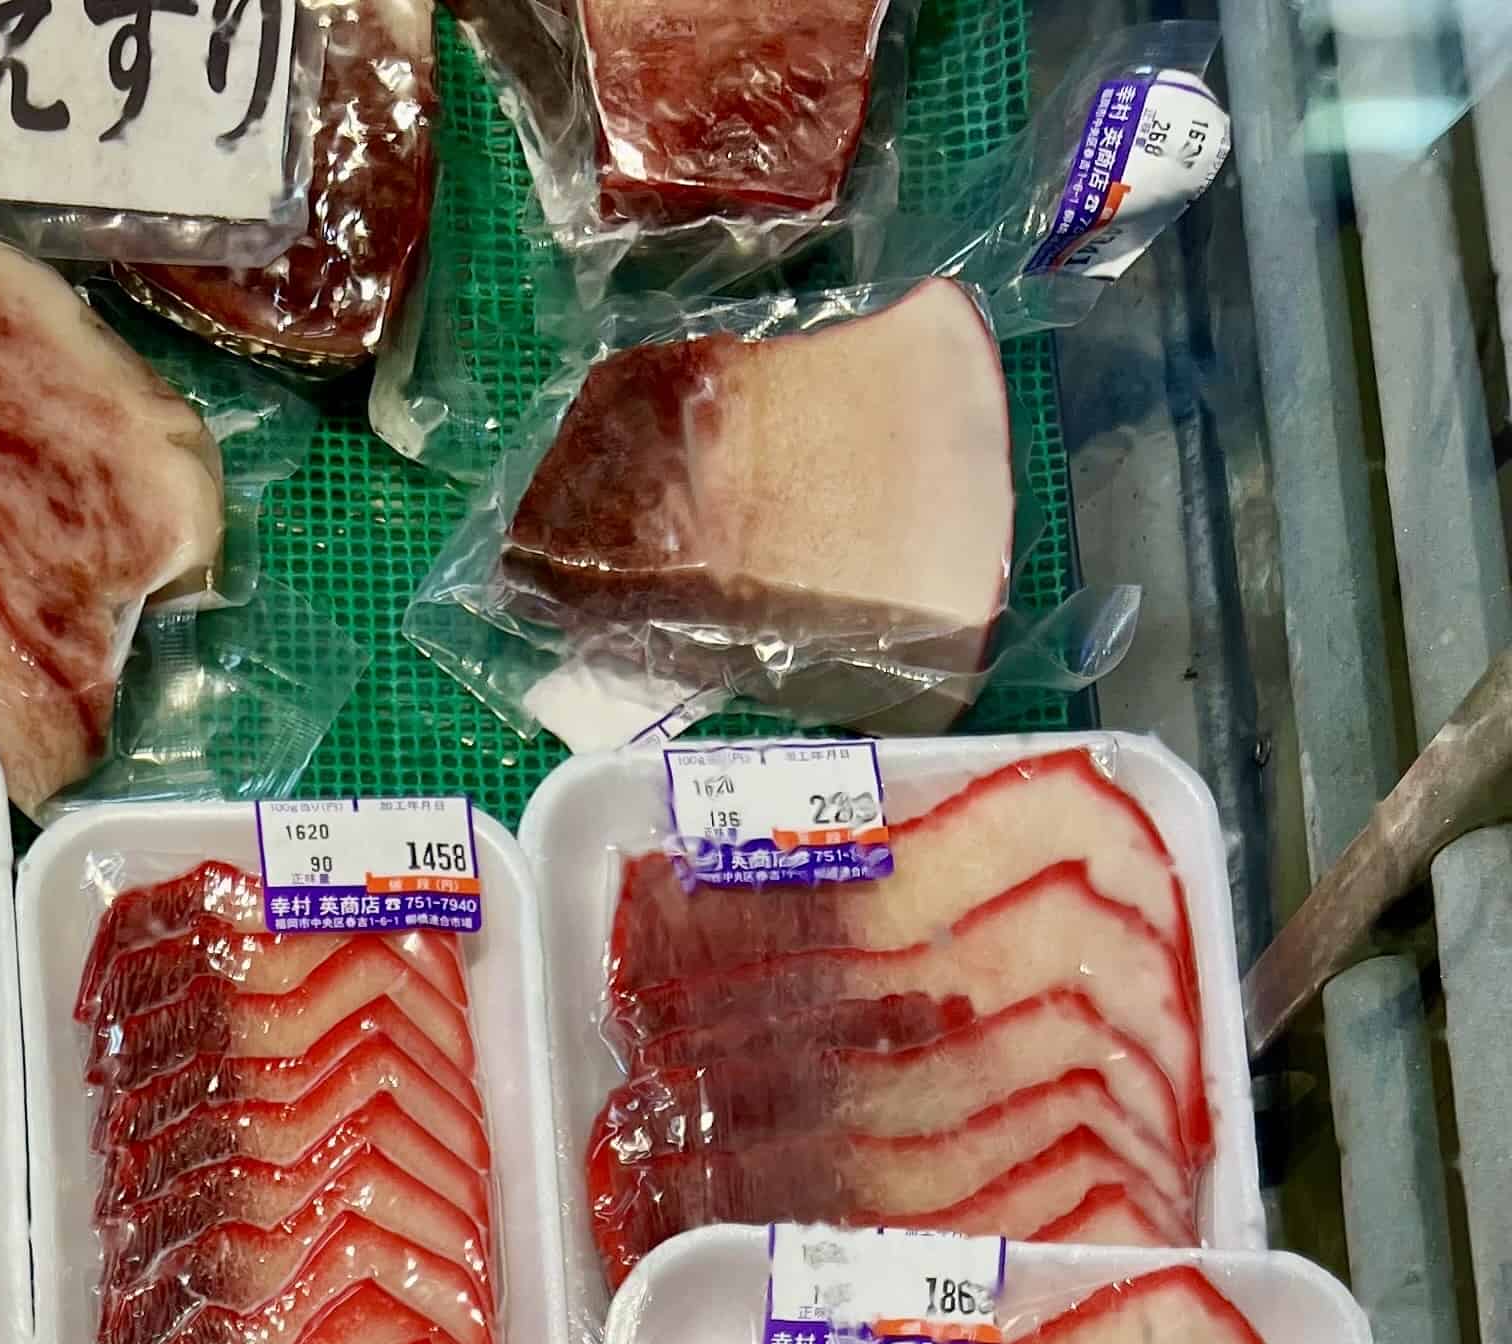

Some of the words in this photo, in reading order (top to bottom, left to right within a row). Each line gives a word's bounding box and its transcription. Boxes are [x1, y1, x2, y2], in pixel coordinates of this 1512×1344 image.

[285, 823, 329, 841] 1620
[311, 856, 333, 873] 90
[406, 842, 466, 871] 1458
[270, 895, 311, 916] 幸村
[319, 895, 380, 915] 英商店
[406, 896, 477, 912] 751-7940
